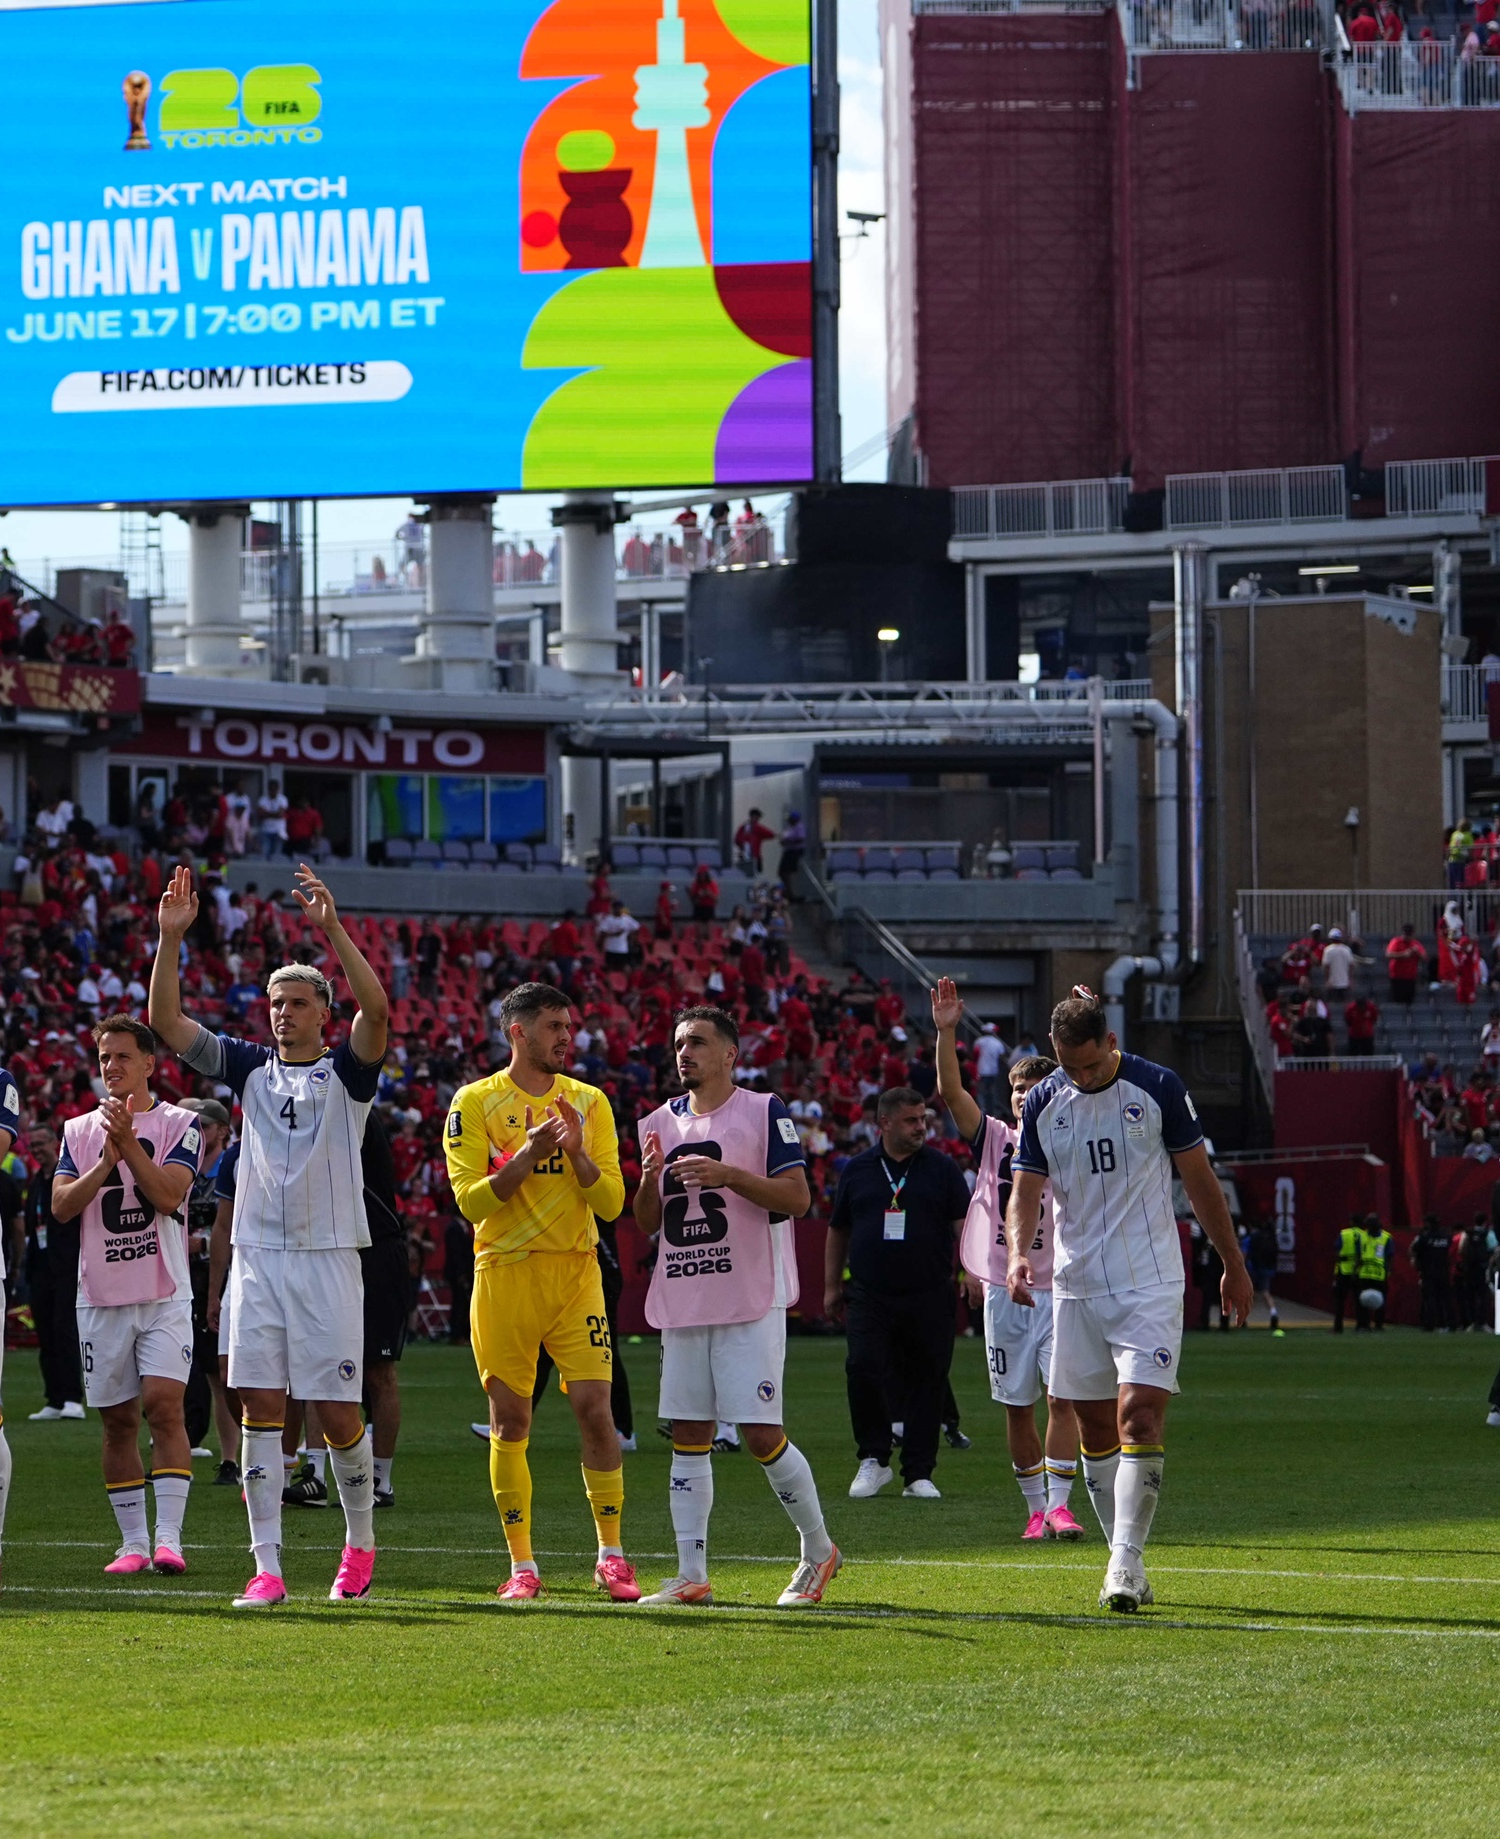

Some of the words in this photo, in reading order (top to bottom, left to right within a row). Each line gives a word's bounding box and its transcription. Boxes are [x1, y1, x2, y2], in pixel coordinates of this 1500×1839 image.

[264, 101, 301, 115] FIFA
[160, 127, 323, 149] TORONTO
[103, 181, 205, 210] NEXT
[211, 175, 348, 205] MATCH
[20, 215, 181, 300] GHANA
[220, 205, 431, 292] PANAMA
[6, 308, 123, 343] JUNE
[311, 299, 381, 331] PM
[390, 296, 446, 327] ET
[100, 362, 367, 393] FIFA.COM/TICKETS
[176, 717, 485, 766] TORONTO
[280, 1096, 297, 1130] 4
[1086, 1138, 1116, 1175] 18
[119, 1212, 146, 1225] FIFA
[682, 1223, 712, 1238] FIFA
[104, 1236, 141, 1248] WORLD
[142, 1230, 157, 1242] CUP
[105, 1241, 158, 1263] 2026
[665, 1248, 706, 1262] WORLD
[707, 1246, 731, 1257] CUP
[666, 1258, 733, 1279] 2026
[989, 1346, 1007, 1375] 20
